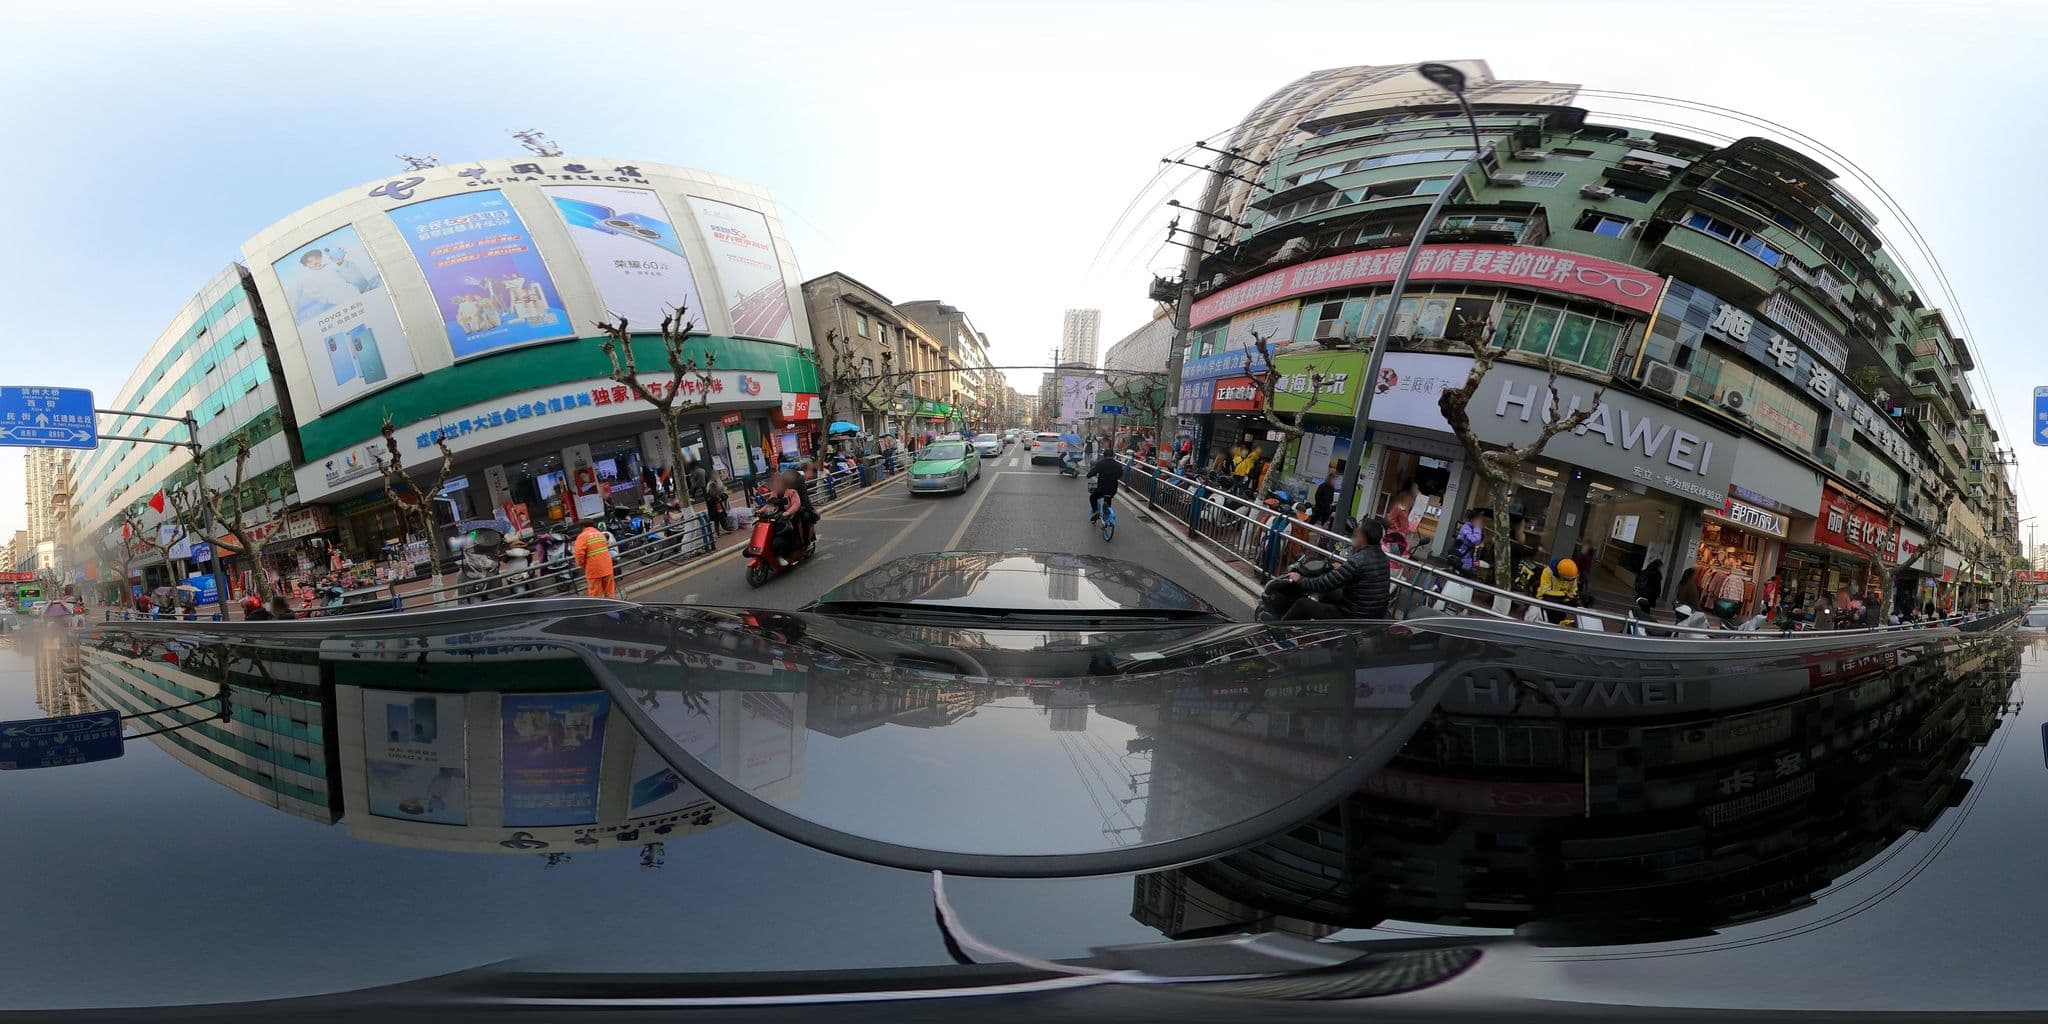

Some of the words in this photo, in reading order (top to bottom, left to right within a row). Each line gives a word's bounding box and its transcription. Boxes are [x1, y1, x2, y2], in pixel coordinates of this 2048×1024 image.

[458, 163, 642, 179] 中国电信
[466, 175, 538, 186] CHINA
[547, 174, 650, 185] TELECOM
[1415, 249, 1576, 283] 带你看更美的世界
[1711, 303, 1831, 397] 施华洛
[416, 391, 591, 449] 成都世界大运会综合信息类
[1496, 380, 1713, 476] HUAWEI
[1731, 502, 1781, 533] 都市丽人
[1827, 504, 1896, 553] 丽佳化妆品
